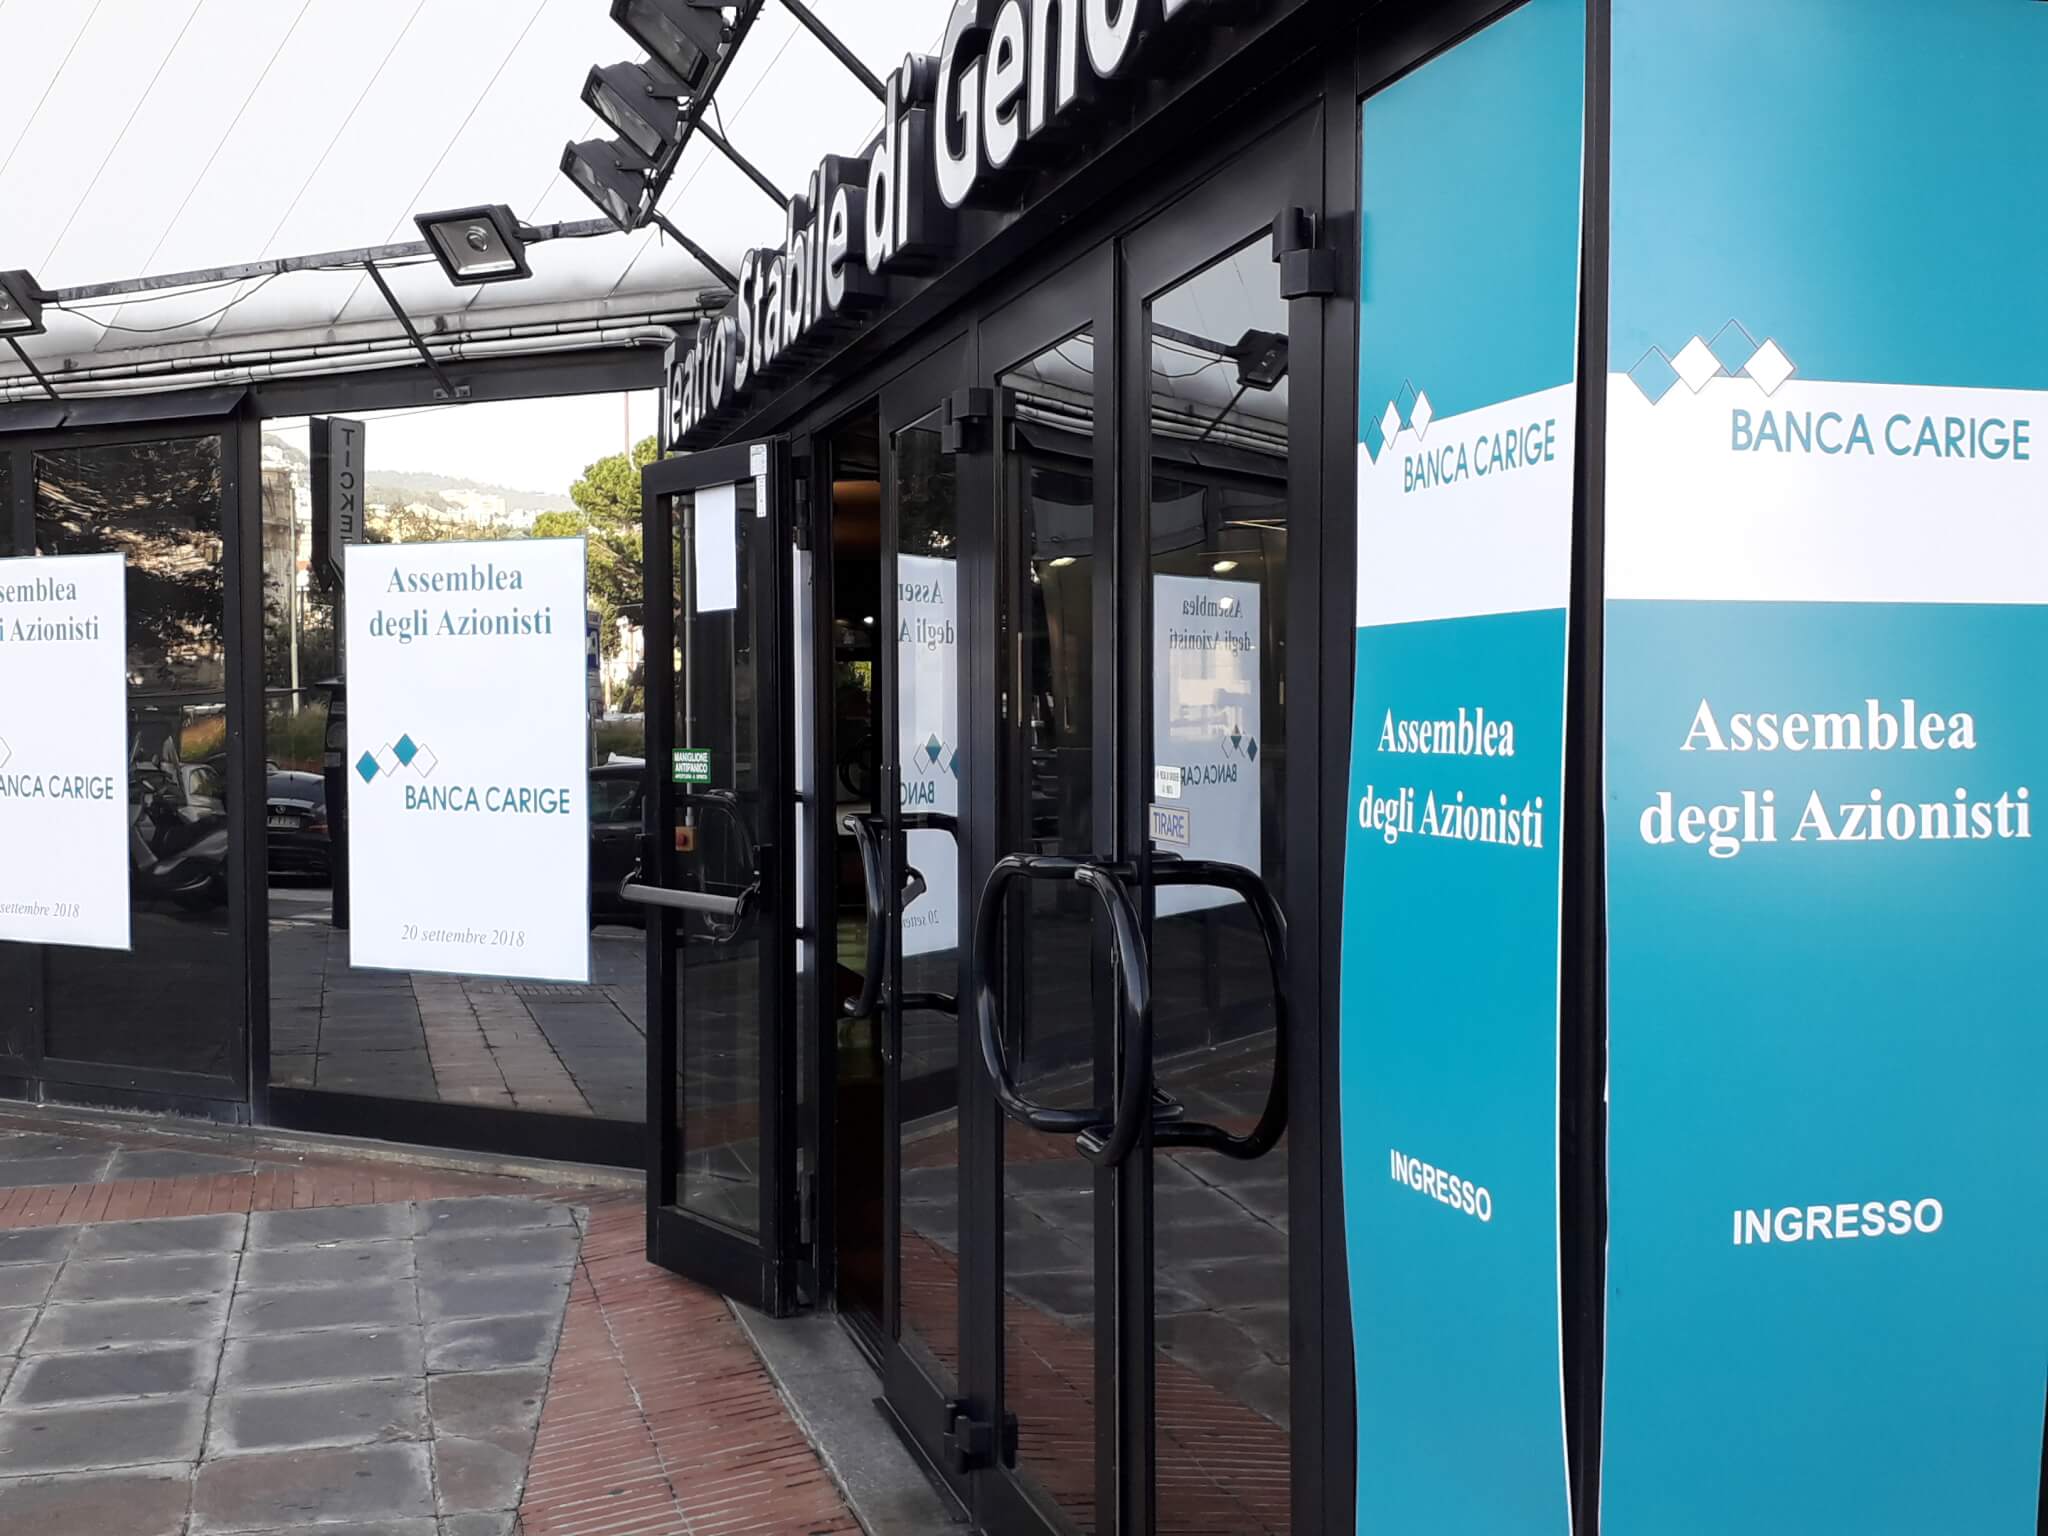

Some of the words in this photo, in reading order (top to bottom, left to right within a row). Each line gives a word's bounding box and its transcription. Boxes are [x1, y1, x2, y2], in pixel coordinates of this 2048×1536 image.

[663, 315, 733, 451] Teatro
[734, 155, 850, 392] Stabile
[865, 52, 914, 274] di
[934, 0, 1190, 208] Gen
[1403, 441, 1470, 493] BANCA
[1474, 419, 1555, 478] CARIGE
[1731, 408, 1875, 455] BANCA
[1885, 415, 2031, 461] CARIGE
[387, 563, 523, 592] Assemblea
[9, 615, 99, 641] Azionisti
[369, 608, 429, 644] degli
[435, 606, 552, 635] Azionisti
[1377, 707, 1516, 756] Assemblea
[1679, 697, 1978, 752] Assemblea
[49, 775, 114, 800] CARIGE
[405, 785, 480, 811] BANCA
[485, 786, 570, 814] CARIGE
[1153, 811, 1184, 839] TIRARE
[1358, 785, 1414, 844] degli
[1421, 791, 1545, 849] Azionisti
[1638, 789, 1778, 858] degli
[1791, 786, 2032, 844] Azionisti
[53, 902, 81, 919] 2018
[401, 923, 418, 941] 20
[421, 927, 487, 944] settembre
[490, 929, 526, 948] 2018
[1390, 1149, 1492, 1222] INGRESSO
[1733, 1197, 1944, 1245] INGRESSO
